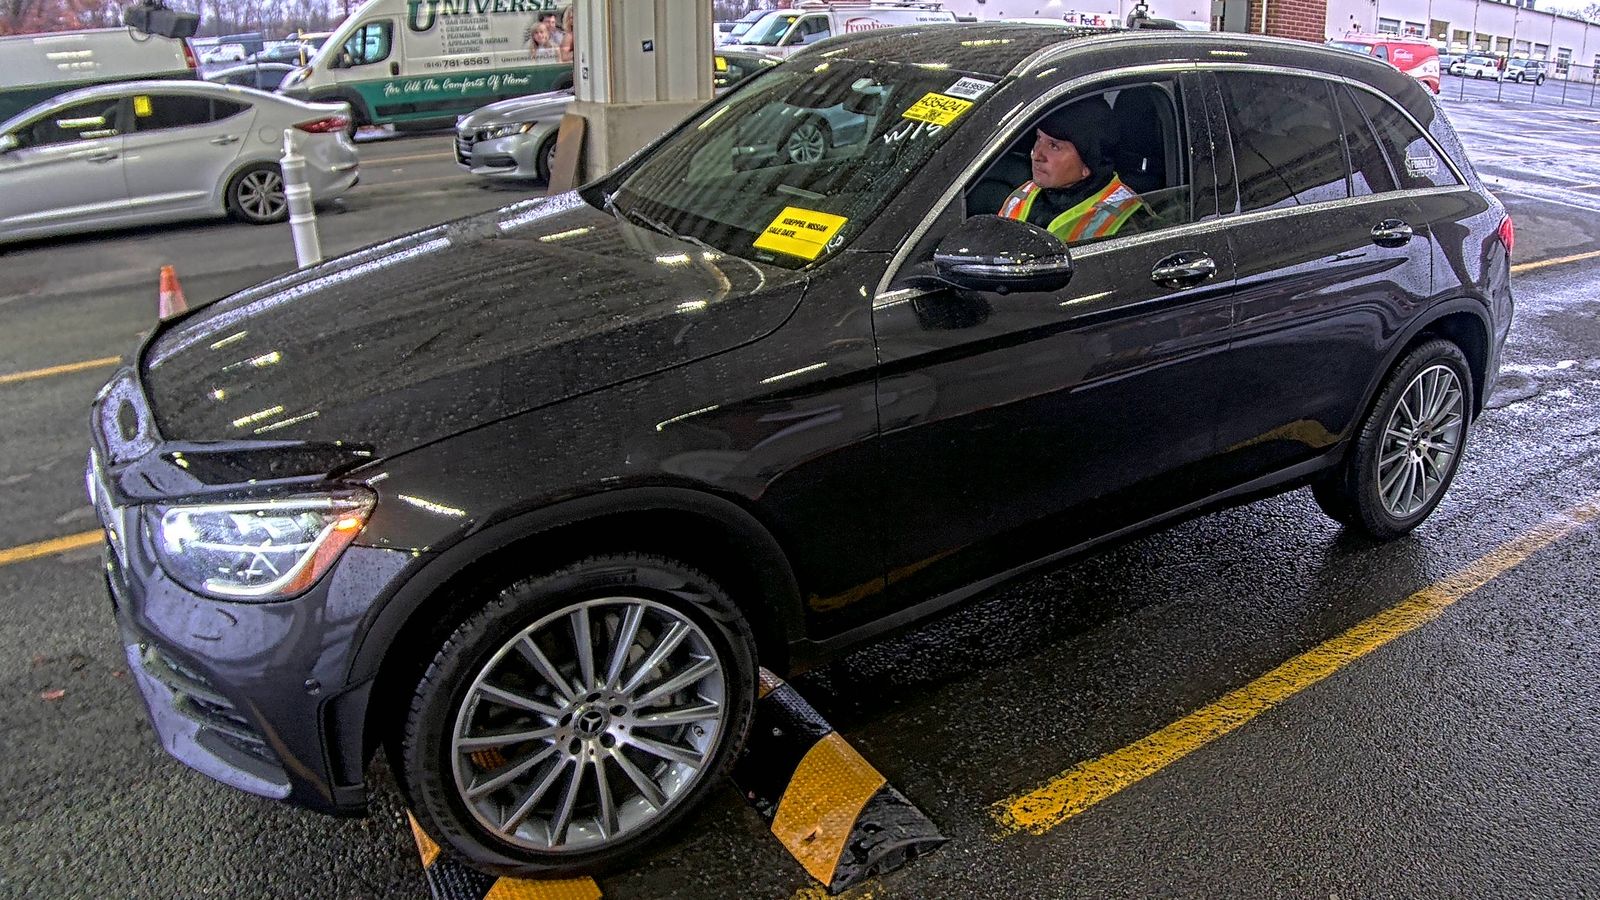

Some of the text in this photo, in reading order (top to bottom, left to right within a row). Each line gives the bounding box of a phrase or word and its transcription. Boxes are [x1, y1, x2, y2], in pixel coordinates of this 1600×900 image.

[408, 0, 557, 32] UNIVERSE
[1080, 14, 1106, 26] FedEx
[447, 38, 483, 46] APPLIANCE
[442, 57, 490, 68] 781-6565
[384, 73, 529, 97] For All The Comforts Of Home
[920, 95, 968, 114] 4354241
[782, 218, 829, 232] KOEPPEL NISSAN
[767, 226, 797, 238] SALE DATE
